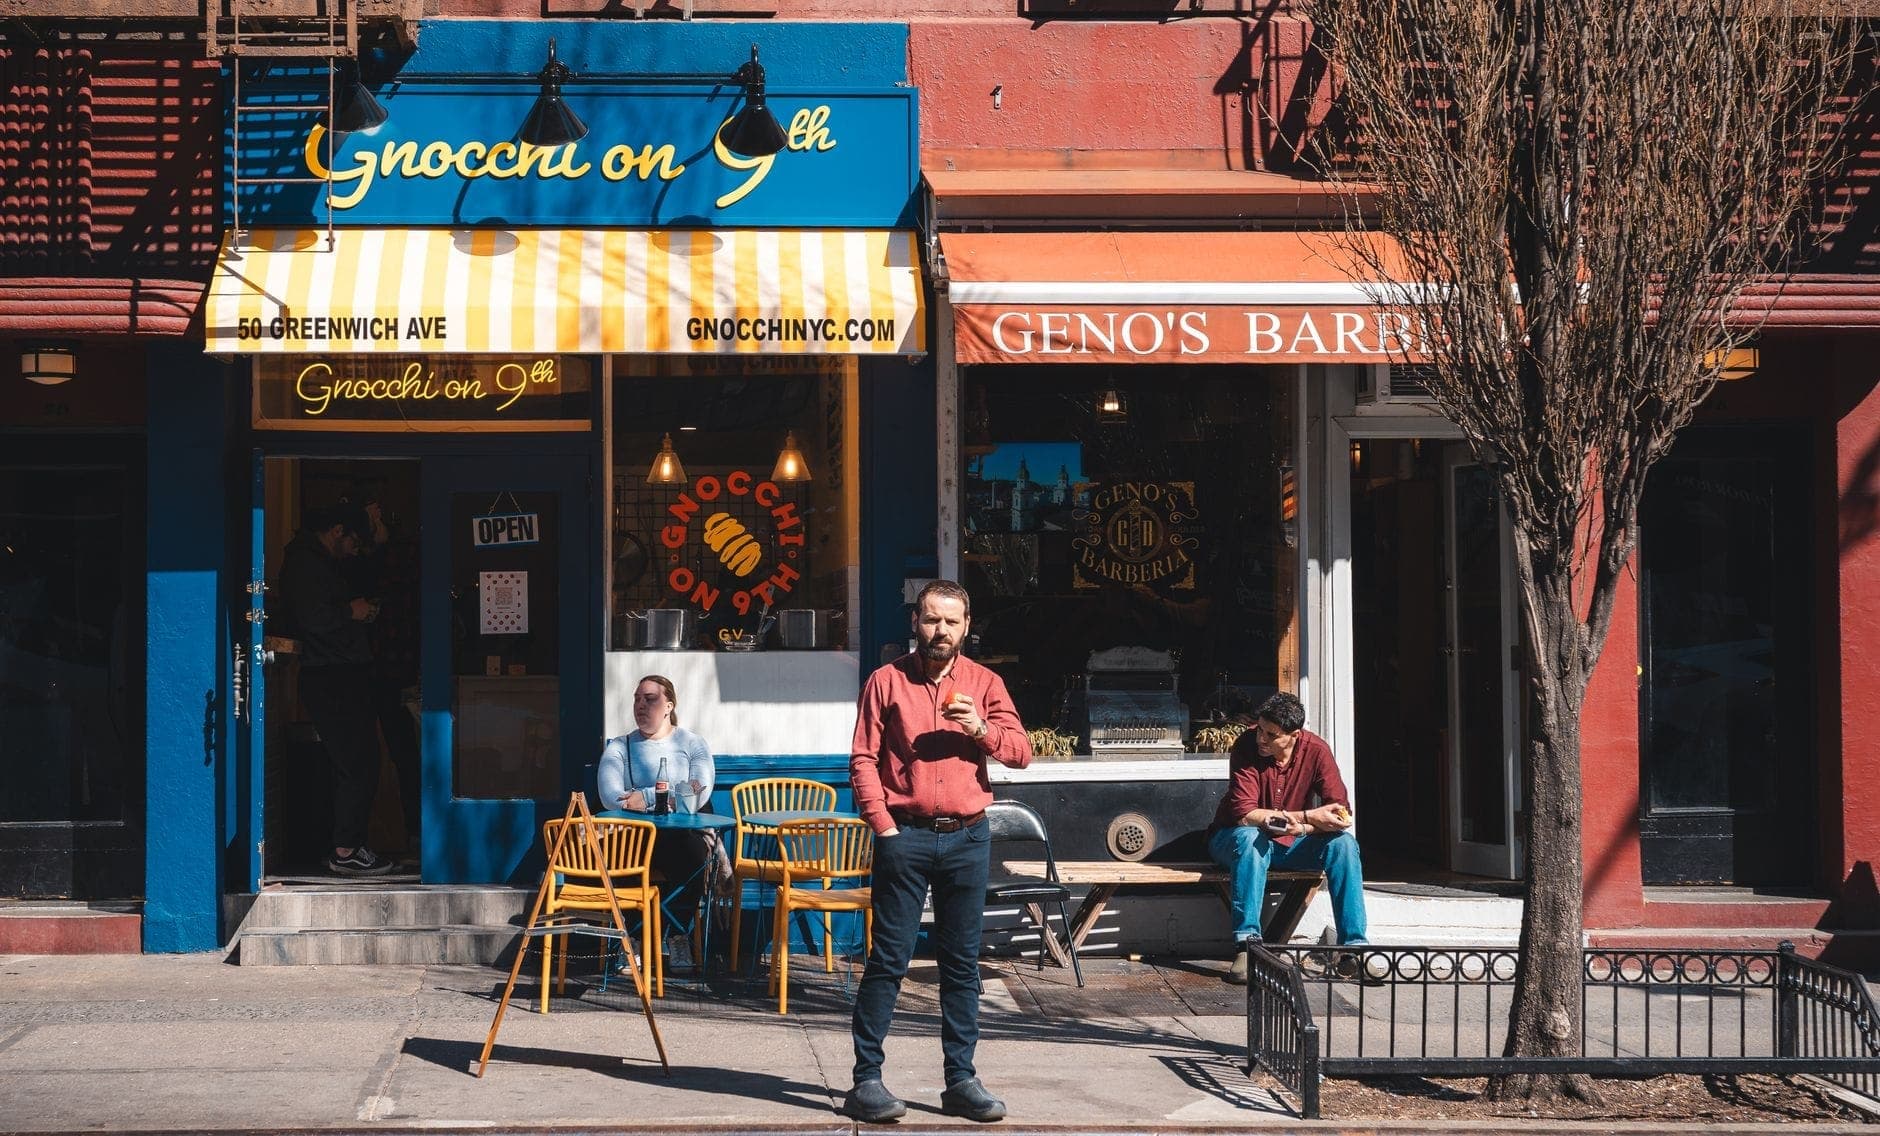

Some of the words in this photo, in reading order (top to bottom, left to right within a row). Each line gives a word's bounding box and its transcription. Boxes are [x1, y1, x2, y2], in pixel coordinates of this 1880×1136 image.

[601, 143, 686, 180] on
[237, 317, 262, 340] 50
[270, 317, 399, 340] GREENWICH
[406, 317, 447, 340] AVE
[686, 317, 895, 342] GNOCCHINYC.COM
[991, 311, 1210, 355] GENO'S
[296, 361, 440, 415] Gnocchi
[445, 378, 487, 399] on
[495, 358, 558, 412] 9th
[660, 470, 805, 549] GNOCCHI
[1094, 480, 1178, 512] GENO'S
[478, 515, 535, 544] OPEN
[1081, 547, 1189, 583] BARBERIA
[669, 567, 721, 612] ON
[732, 562, 801, 616] 9TH
